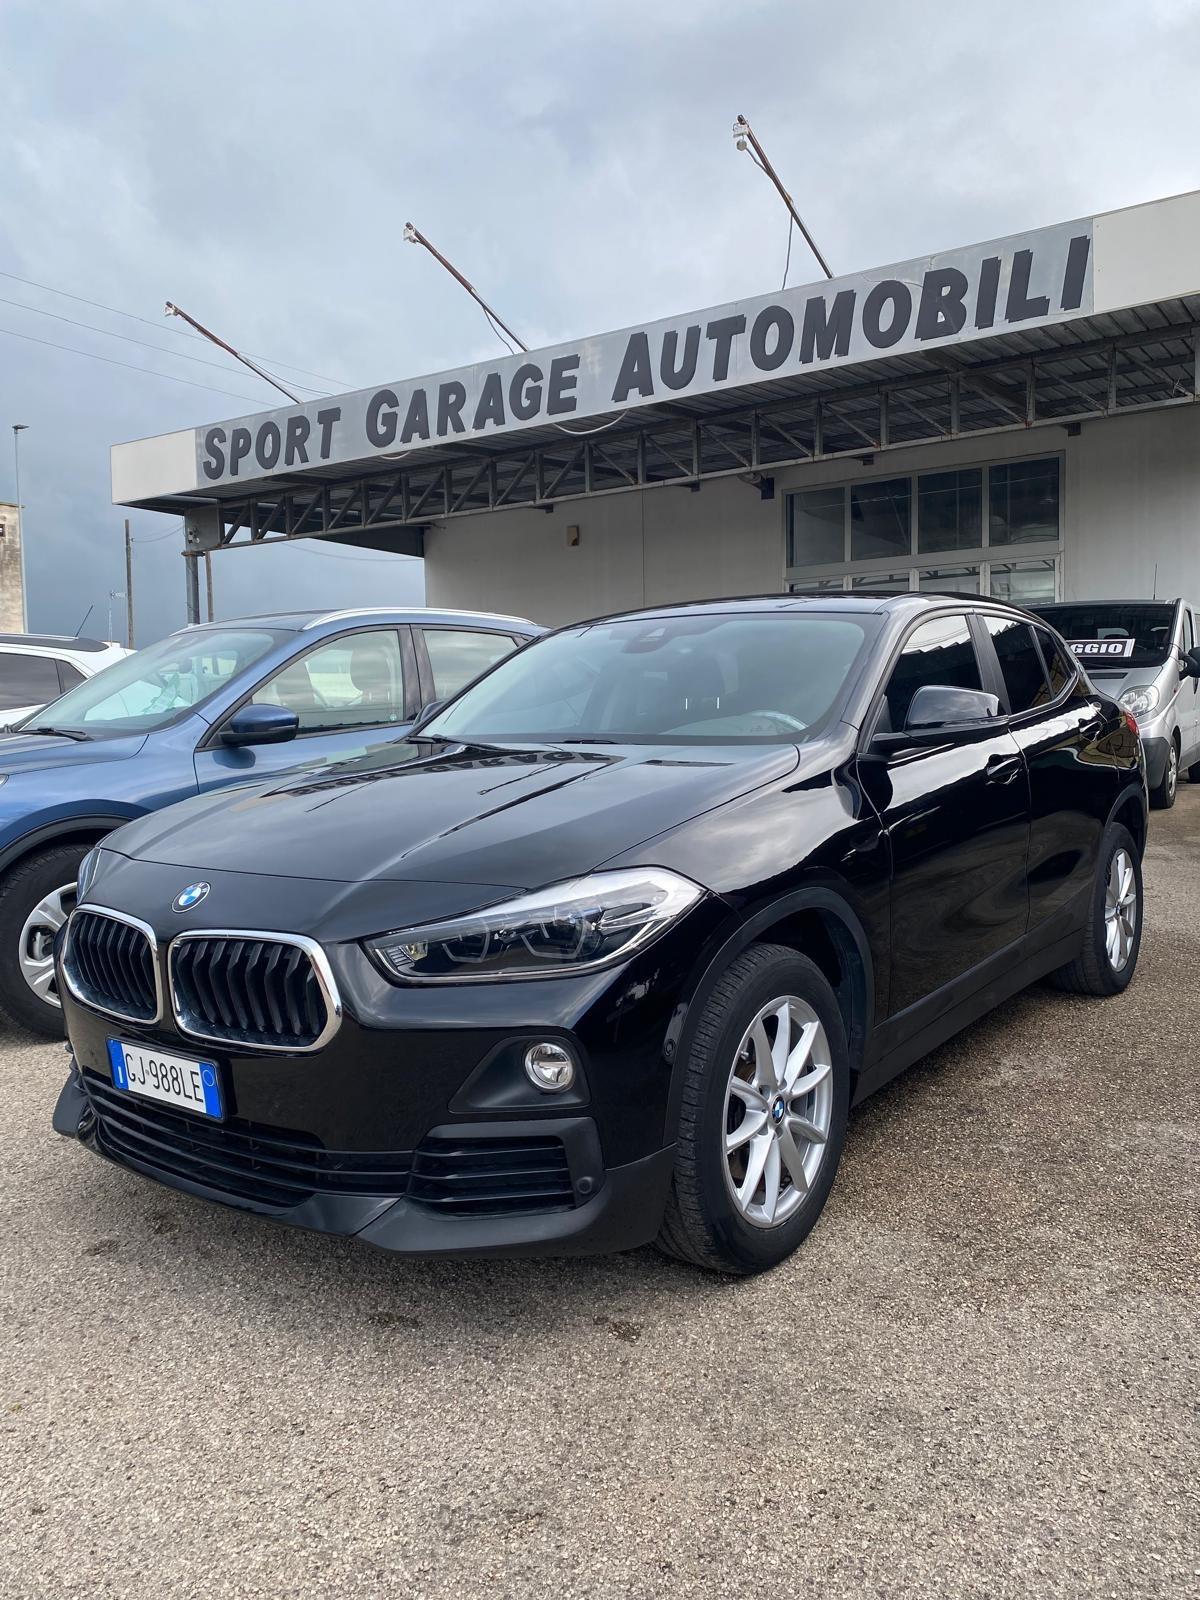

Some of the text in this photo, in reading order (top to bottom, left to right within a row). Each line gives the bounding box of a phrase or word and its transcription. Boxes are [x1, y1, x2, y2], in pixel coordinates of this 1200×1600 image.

[202, 235, 1091, 480] SPORT GARAGE AUTOMOBILI
